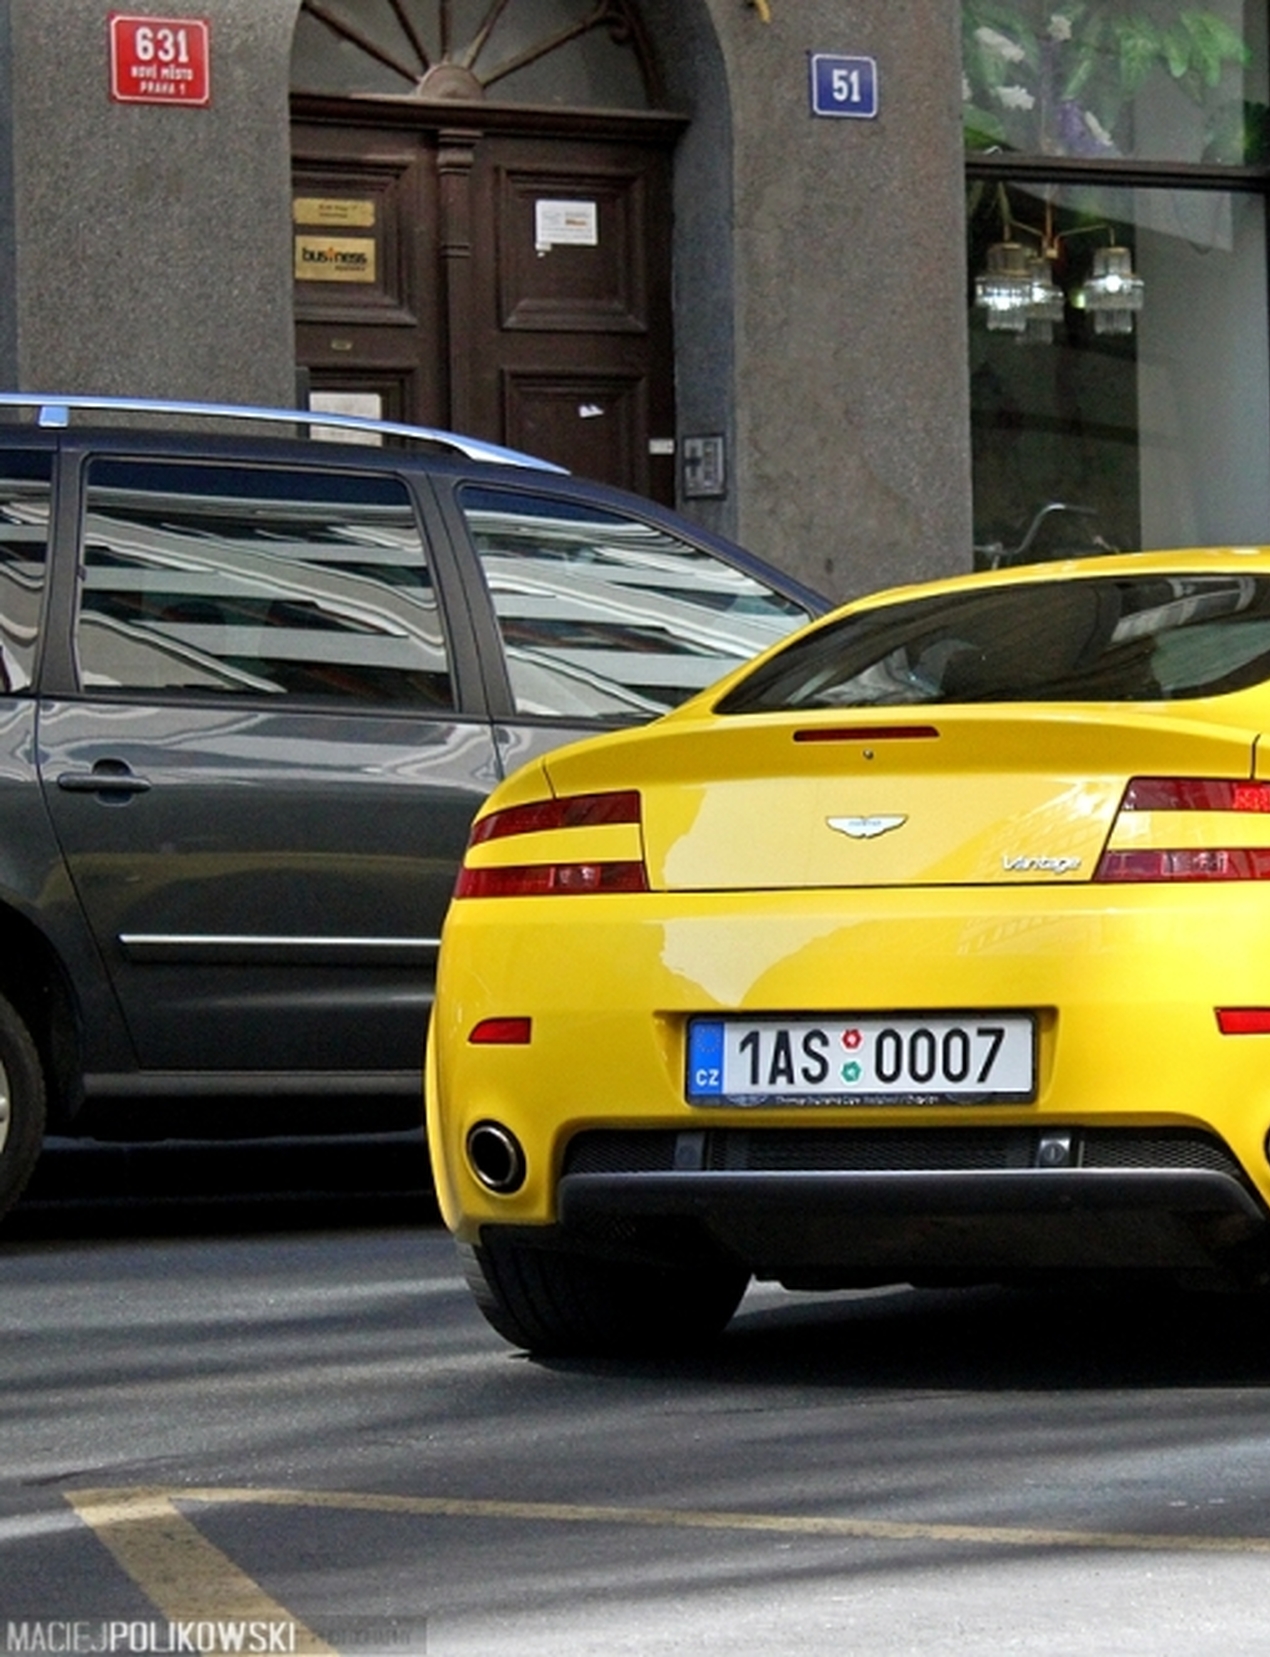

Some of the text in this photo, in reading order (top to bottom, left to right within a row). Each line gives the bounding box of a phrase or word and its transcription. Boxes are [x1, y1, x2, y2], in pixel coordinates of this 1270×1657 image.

[135, 26, 189, 63] 631
[140, 80, 186, 95] PRAHA 1
[832, 69, 861, 102] 51
[1003, 855, 1081, 875] Vantage
[739, 1028, 1005, 1085] 1AS 0007
[695, 1068, 719, 1086] CZ
